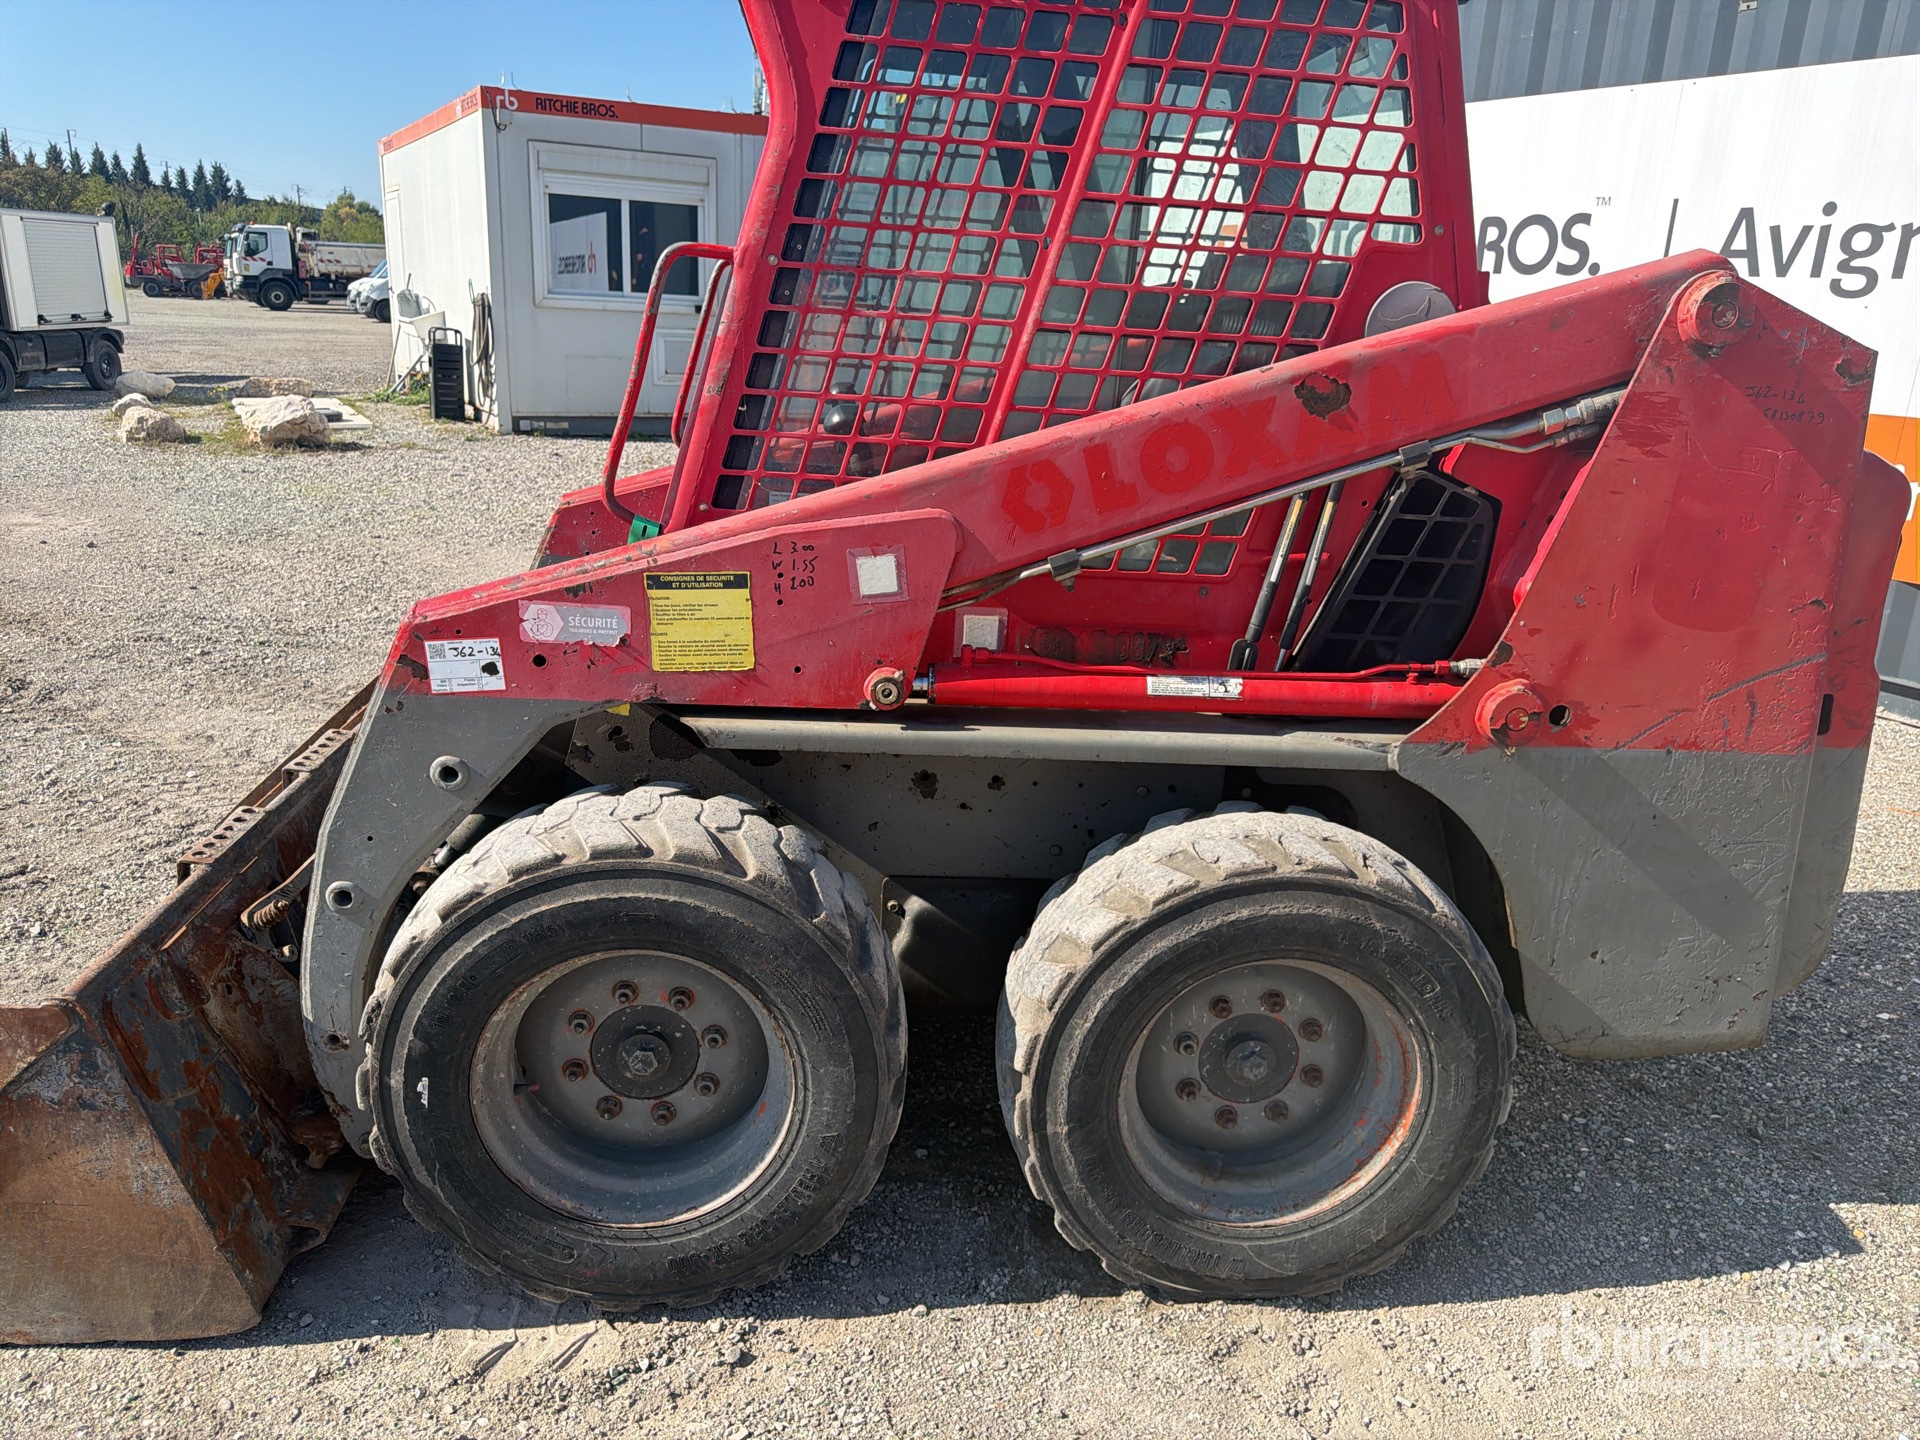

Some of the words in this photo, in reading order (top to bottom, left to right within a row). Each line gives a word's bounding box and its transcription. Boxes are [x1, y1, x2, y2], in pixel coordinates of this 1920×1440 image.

[535, 97, 580, 115] RITCHIE
[581, 102, 619, 119] BROS.
[1083, 353, 1459, 515] LOXAM
[773, 541, 783, 554] L
[771, 560, 782, 570] W
[792, 555, 819, 574] 1.55
[773, 583, 781, 595] H
[568, 614, 618, 628] SÉCURITÉ
[737, 1156, 833, 1246] TRELLEBORG
[1120, 1209, 1221, 1269] TRELLEBORG
